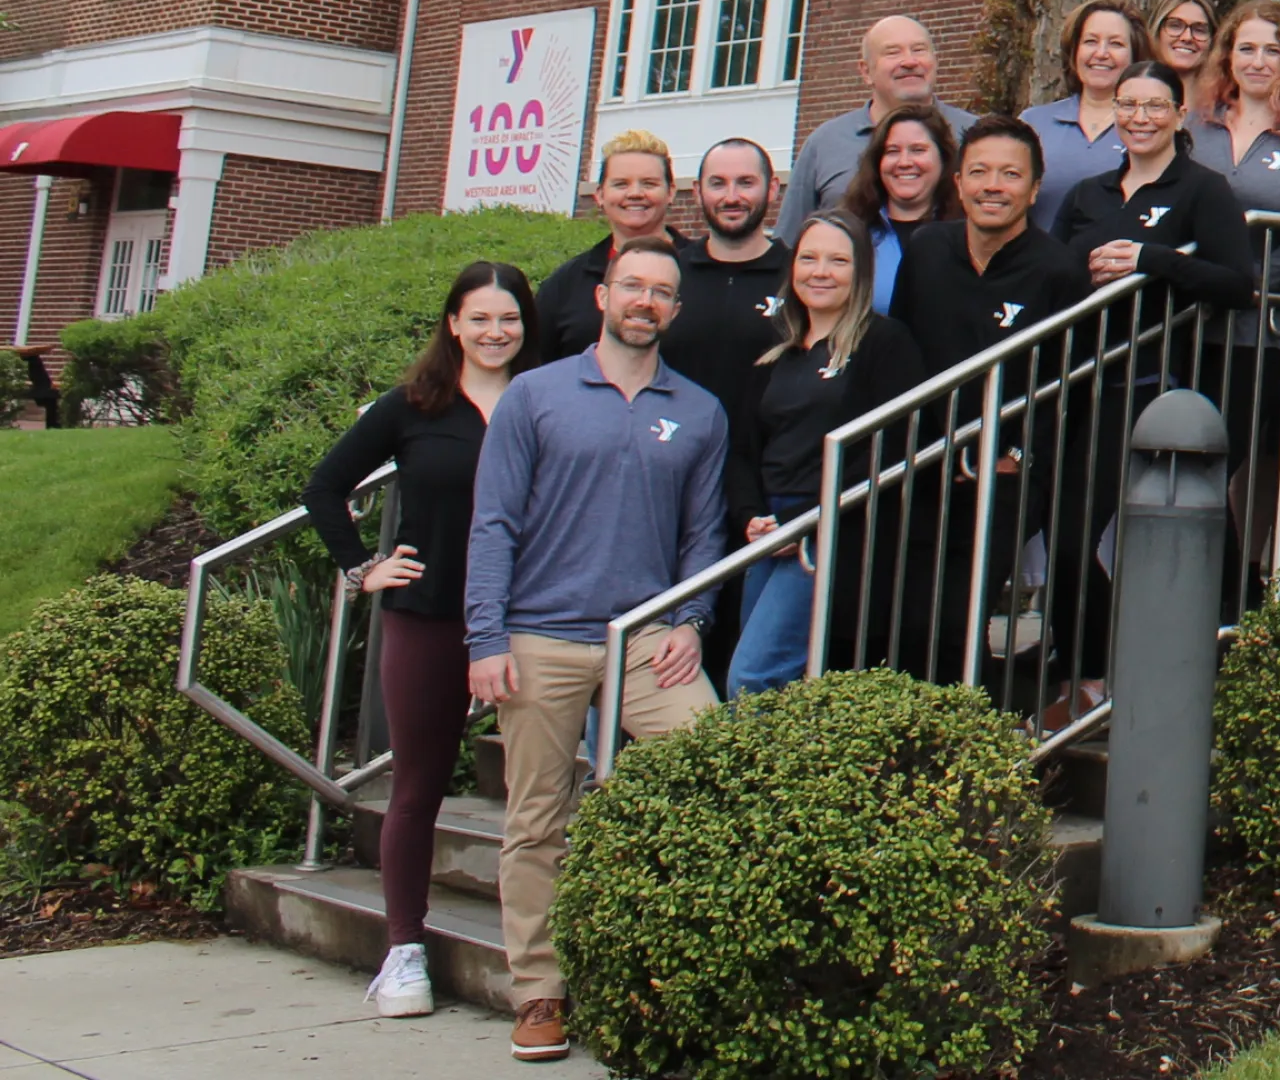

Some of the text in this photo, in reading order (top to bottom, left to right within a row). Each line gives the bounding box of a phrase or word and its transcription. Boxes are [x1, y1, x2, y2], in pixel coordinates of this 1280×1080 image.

[468, 99, 544, 177] 100
[464, 186, 499, 198] WESTFIELD
[500, 185, 517, 196] AREA
